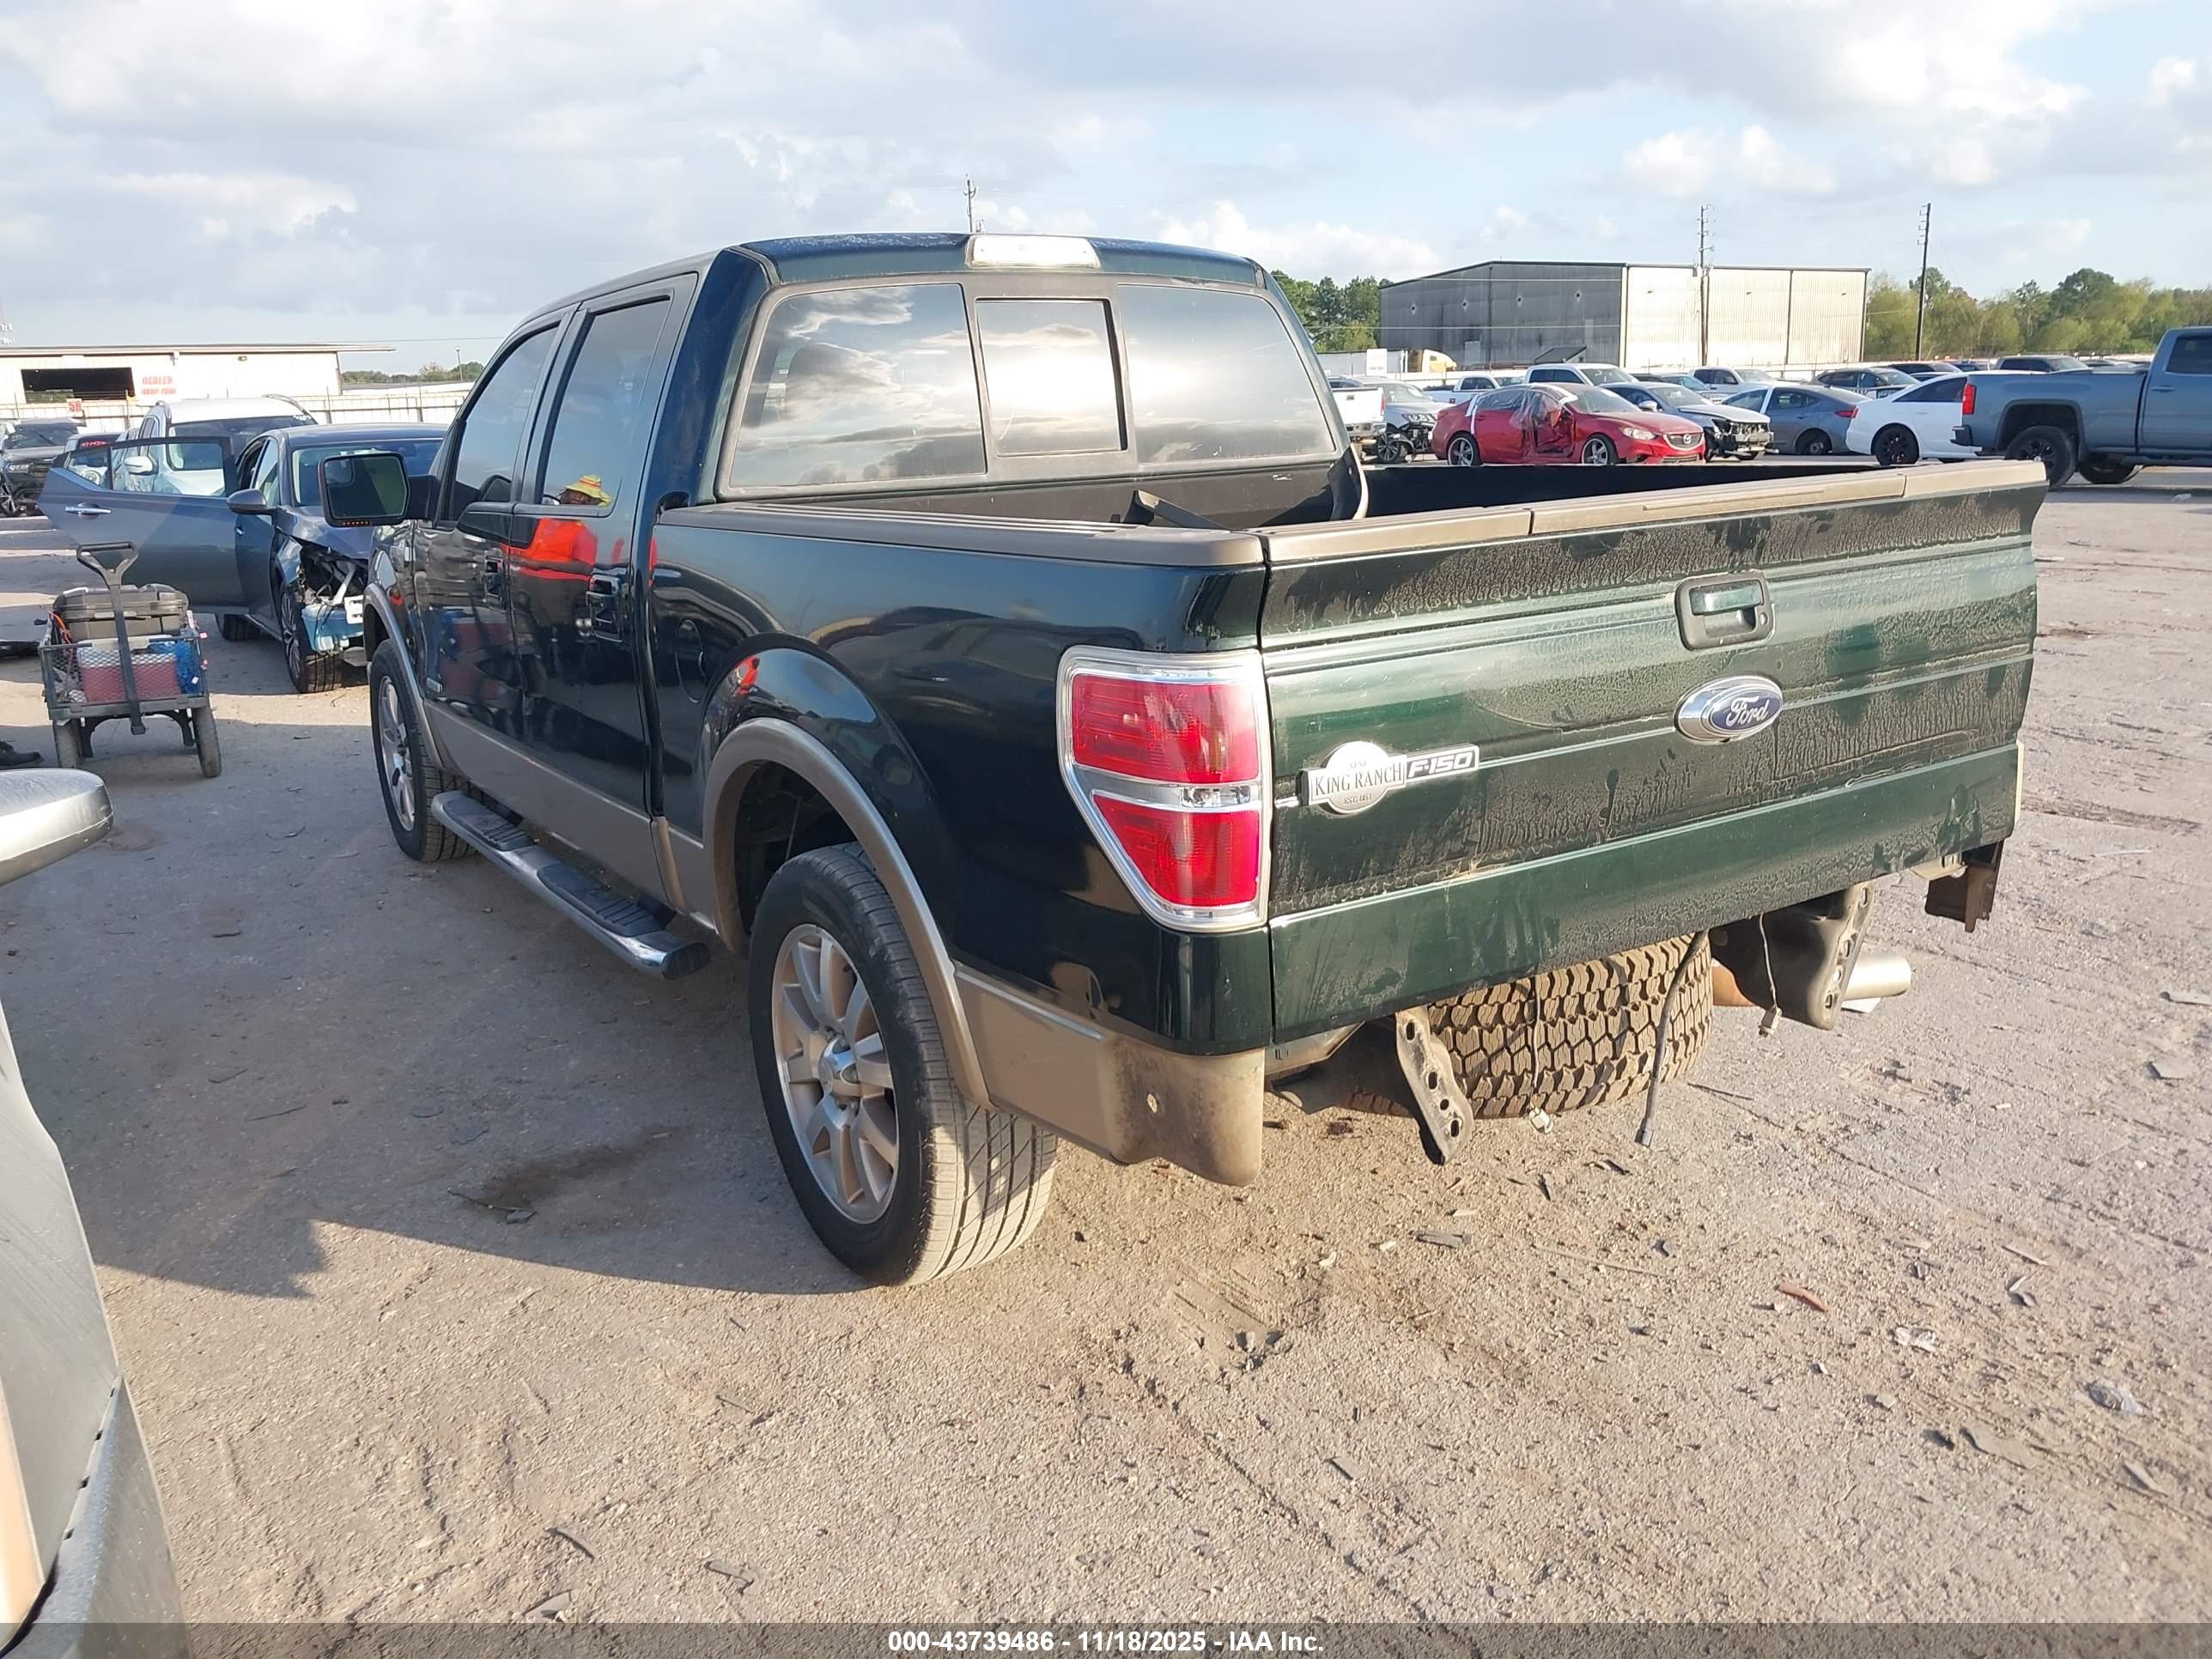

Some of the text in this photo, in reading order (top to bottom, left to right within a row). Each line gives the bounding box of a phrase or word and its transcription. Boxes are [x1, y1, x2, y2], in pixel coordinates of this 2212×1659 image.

[1725, 696, 1770, 726] Ford
[1316, 762, 1402, 796] KING RANCH
[1408, 752, 1474, 778] F-150
